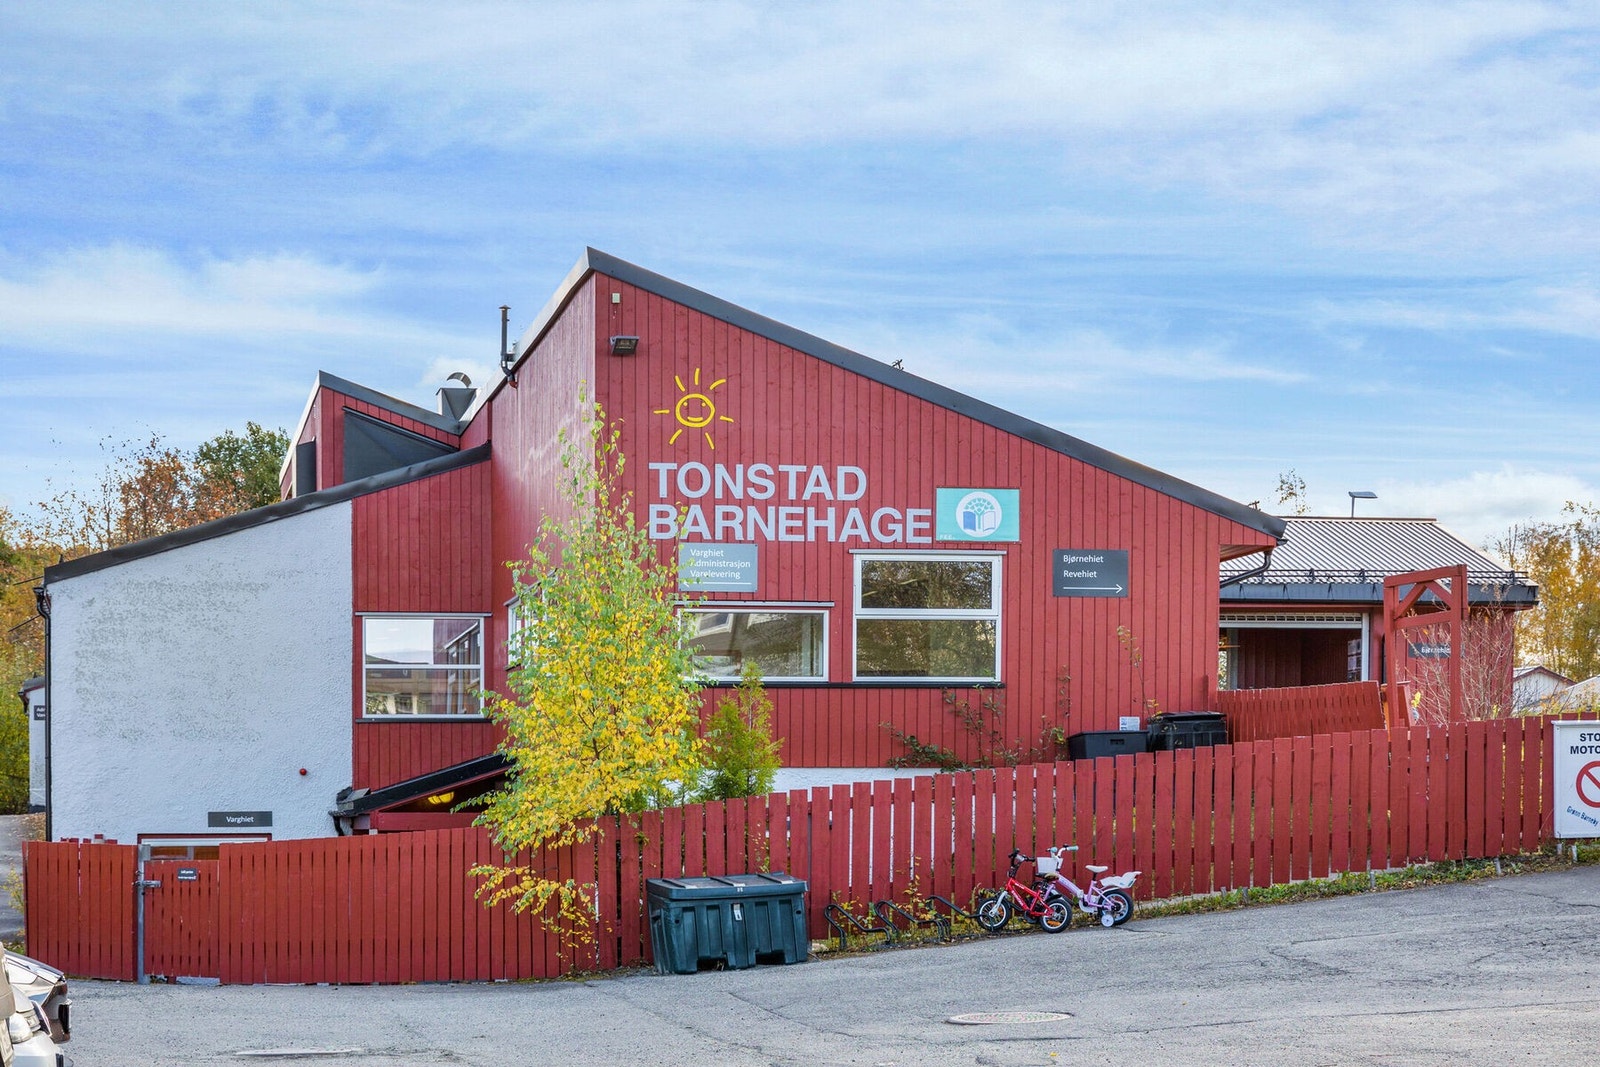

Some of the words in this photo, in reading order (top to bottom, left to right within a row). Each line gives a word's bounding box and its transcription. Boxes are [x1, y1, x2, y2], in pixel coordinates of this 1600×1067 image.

[648, 461, 868, 501] TONSTAD
[648, 503, 933, 544] BARNEHAGE
[690, 548, 724, 558] Varghiet
[1063, 554, 1104, 564] Bjørnehiet
[690, 570, 741, 579] Varelevering
[1063, 569, 1097, 578] Revehiet
[226, 816, 254, 824] Varghiet
